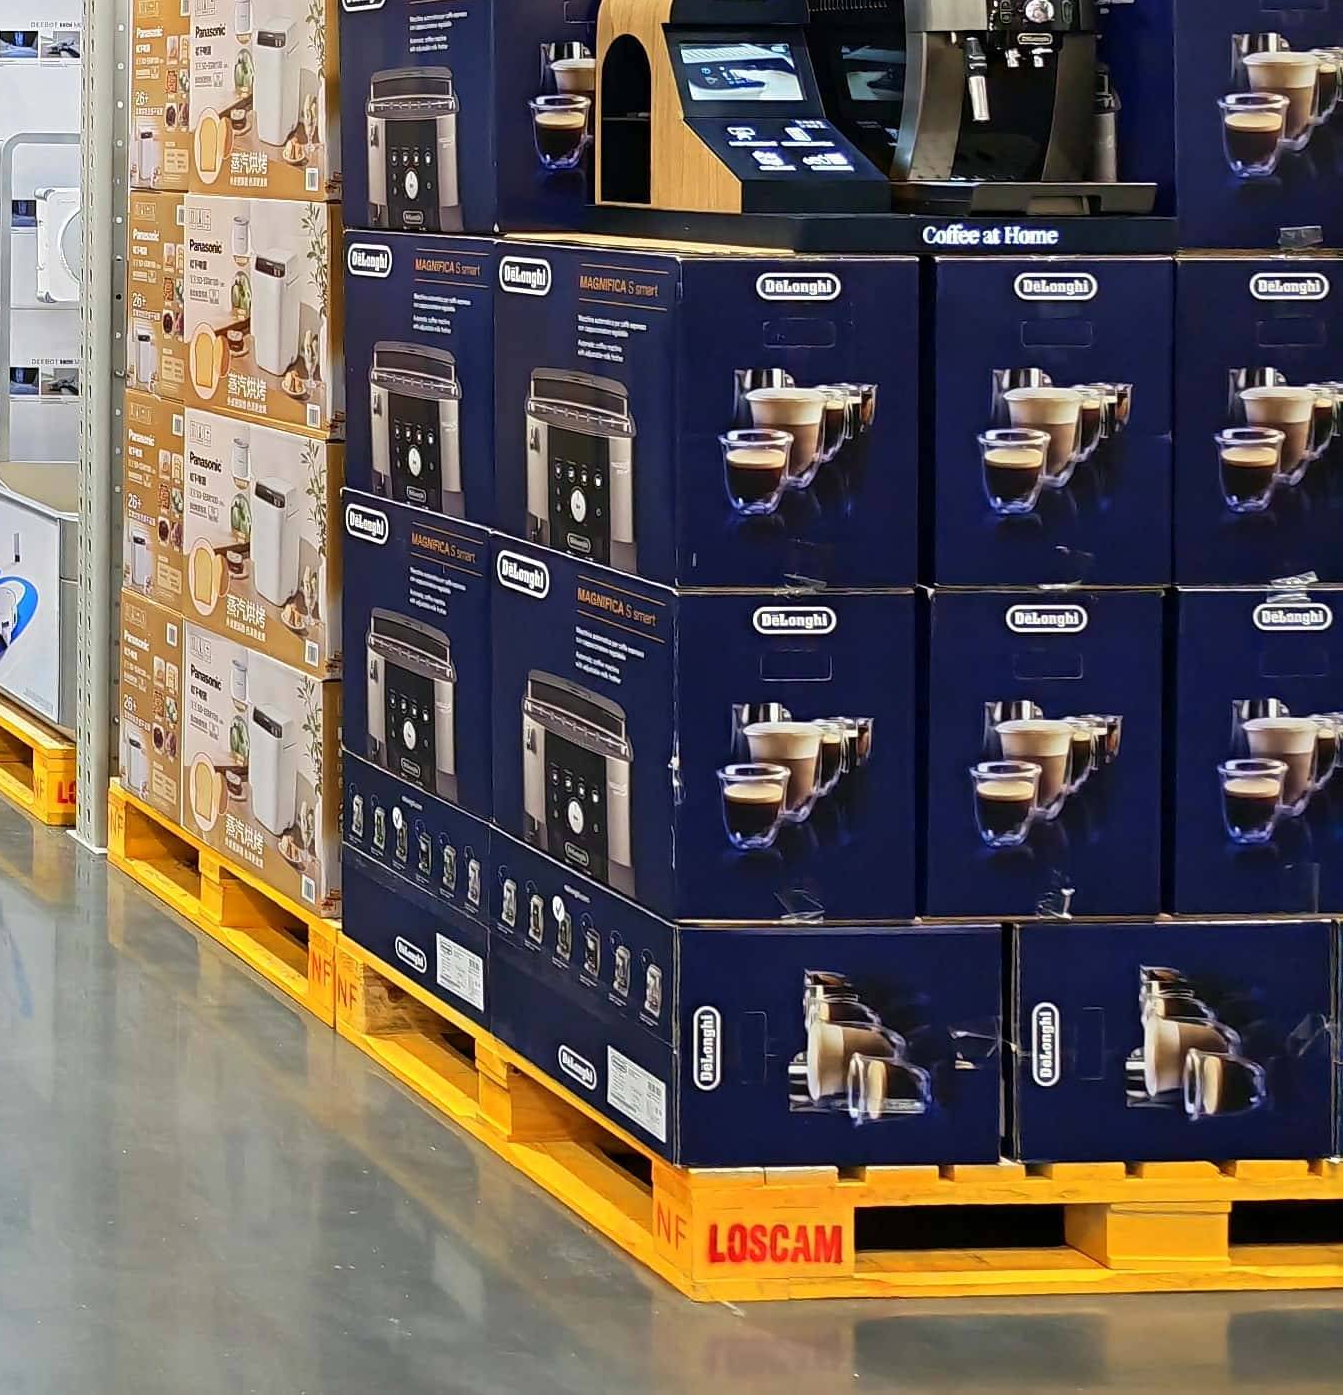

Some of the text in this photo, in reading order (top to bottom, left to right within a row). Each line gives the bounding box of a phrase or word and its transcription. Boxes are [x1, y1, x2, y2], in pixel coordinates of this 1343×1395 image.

[195, 23, 226, 39] Panasonic
[230, 152, 268, 177] 蒸汽烘烤
[189, 239, 223, 255] Panasonic
[922, 225, 1059, 246] Coffee at Home
[414, 257, 455, 275] MAGNIFICA
[462, 262, 481, 277] smart
[579, 275, 627, 294] MAGNIFICA
[635, 282, 659, 297] smart
[227, 373, 267, 402] 蒸汽烘烤
[189, 451, 222, 474] Panasonic
[411, 531, 450, 557] MAGNIFICA
[458, 547, 476, 564] smart
[225, 595, 267, 627] 蒸汽烘烤
[577, 587, 624, 616] MAGNIFICA
[633, 605, 657, 626] smart
[190, 664, 222, 692] Panasonic
[224, 813, 265, 856] 蒸汽烘烤
[653, 1202, 688, 1254] NF
[707, 1223, 843, 1265] LOSCAM
